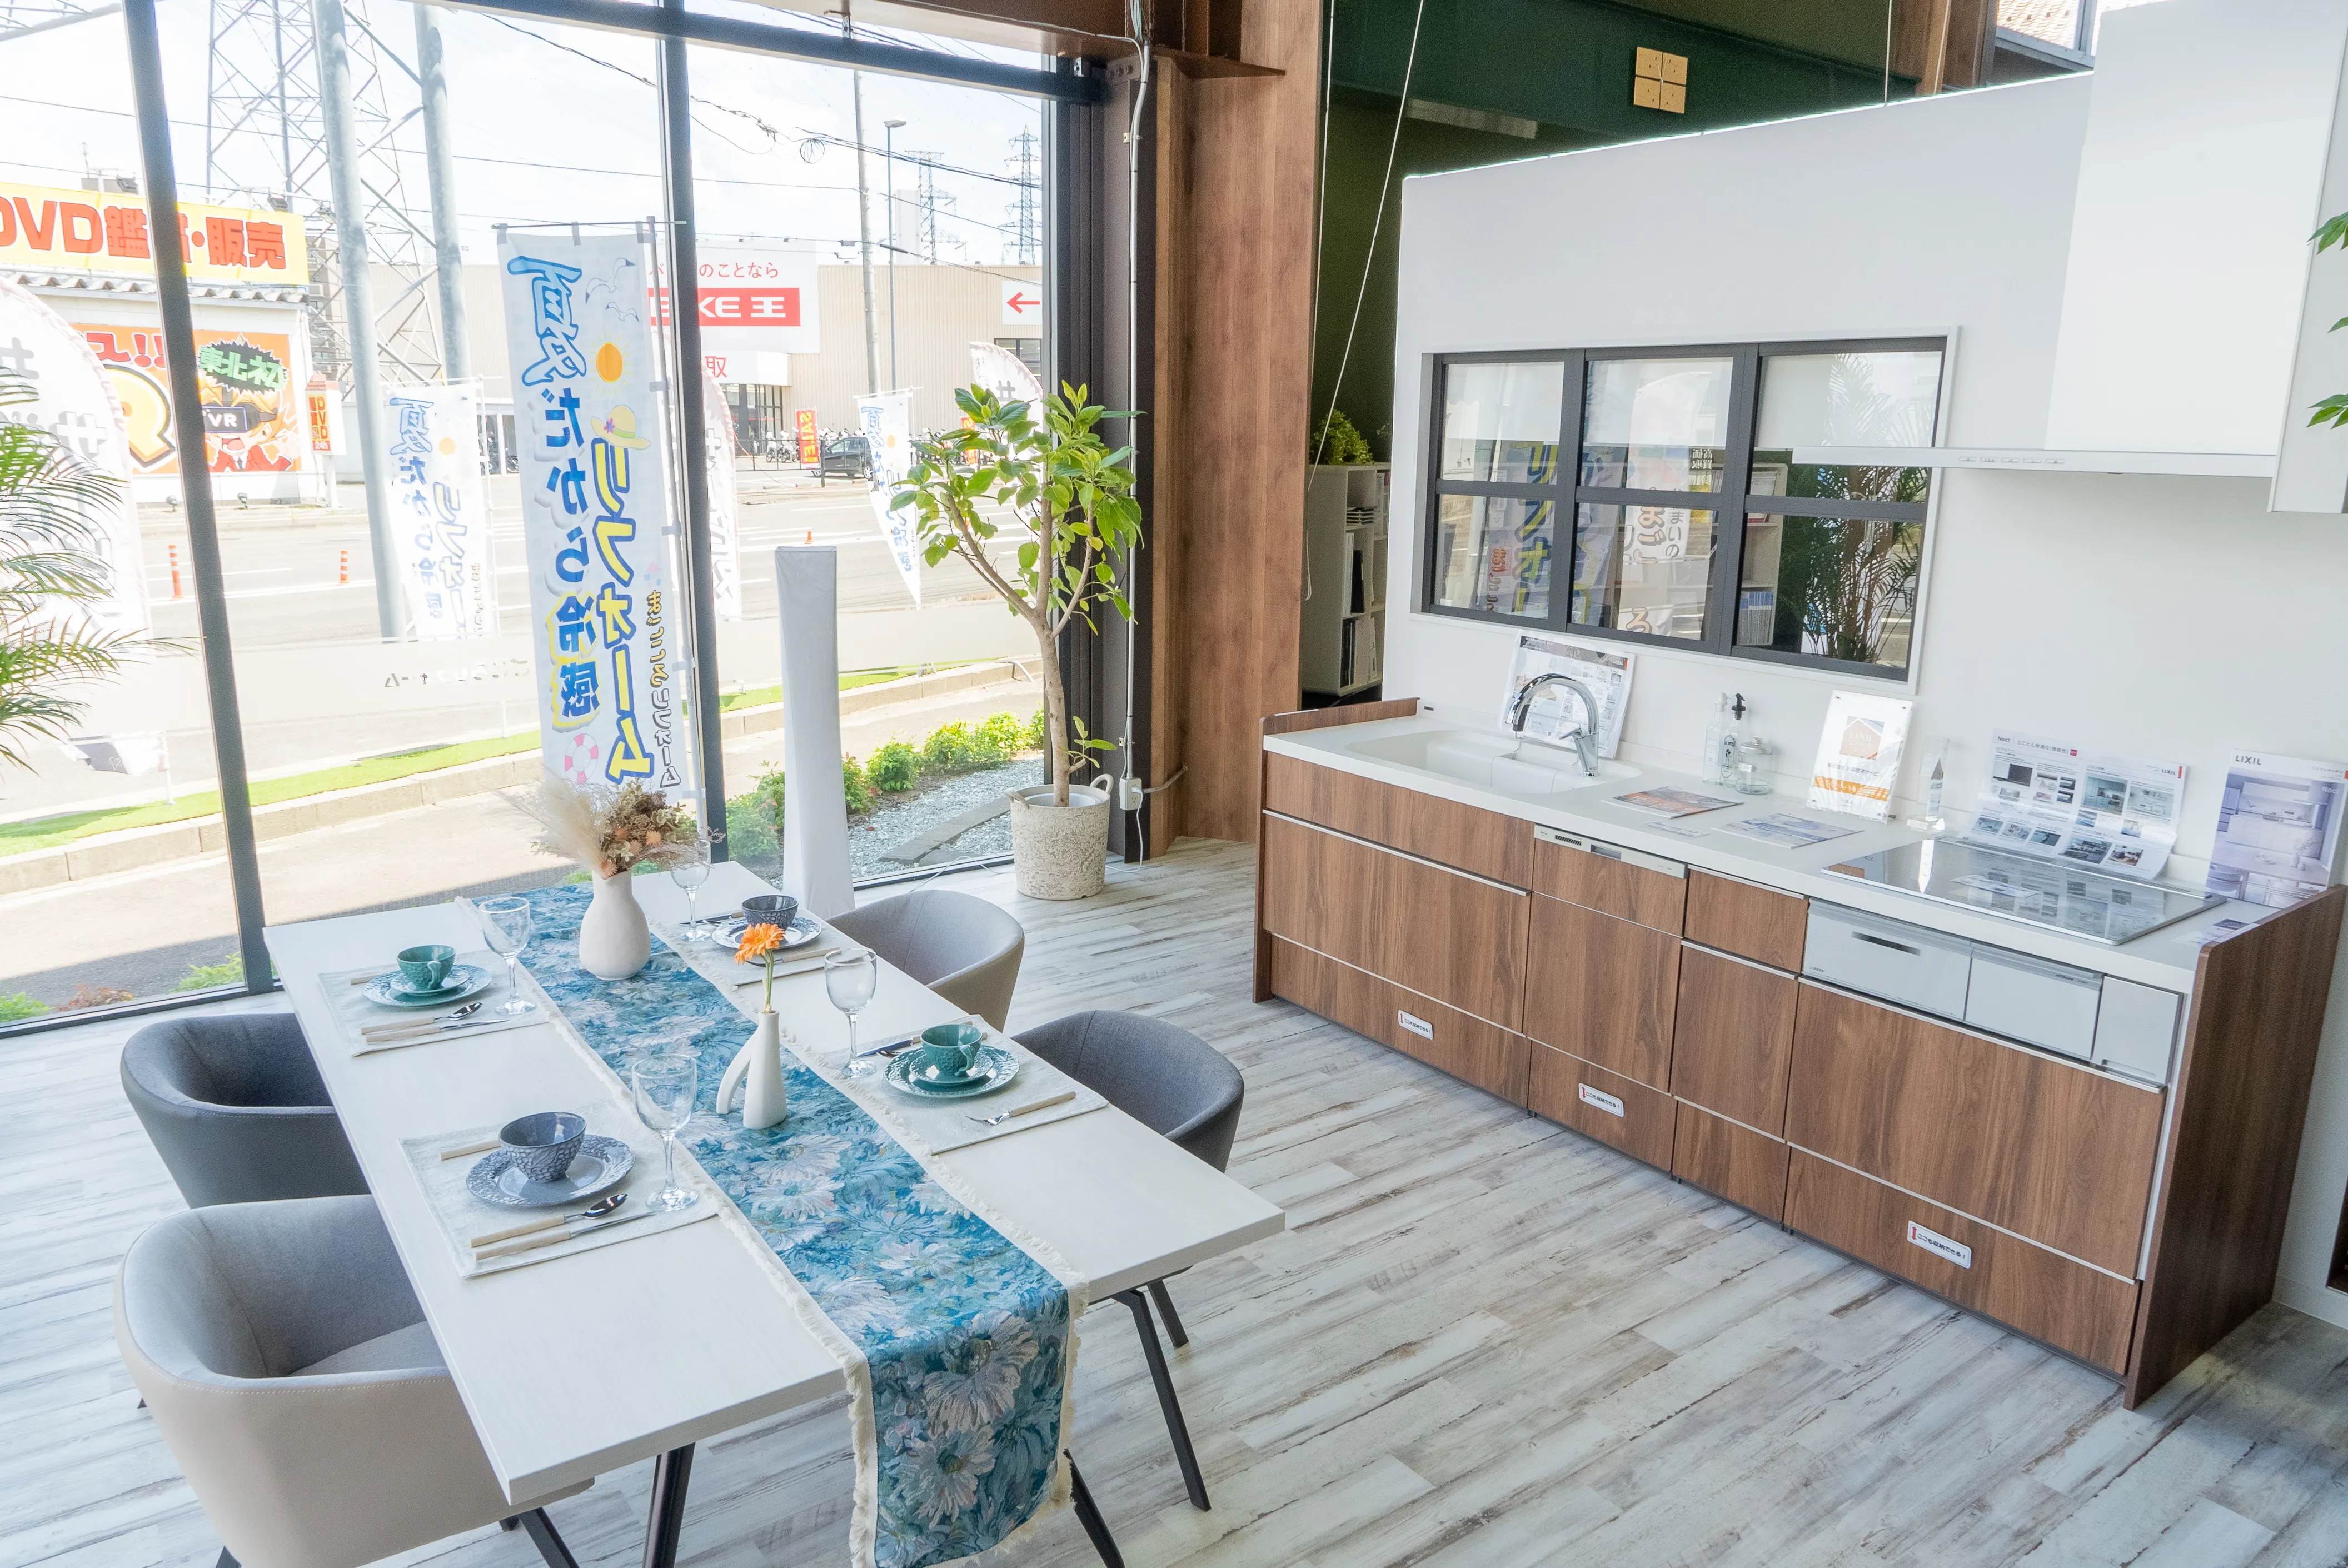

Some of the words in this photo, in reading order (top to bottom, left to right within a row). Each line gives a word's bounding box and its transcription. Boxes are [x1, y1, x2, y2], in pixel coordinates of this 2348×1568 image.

[0, 197, 287, 270] VD鑑・販売
[649, 262, 779, 278] バのことなら
[198, 346, 285, 390] 東北初
[207, 412, 237, 427] VR
[317, 396, 328, 440] DVD
[2235, 755, 2262, 765] LIXIL
[1917, 1233, 1966, 1259] ここも収納できる！
